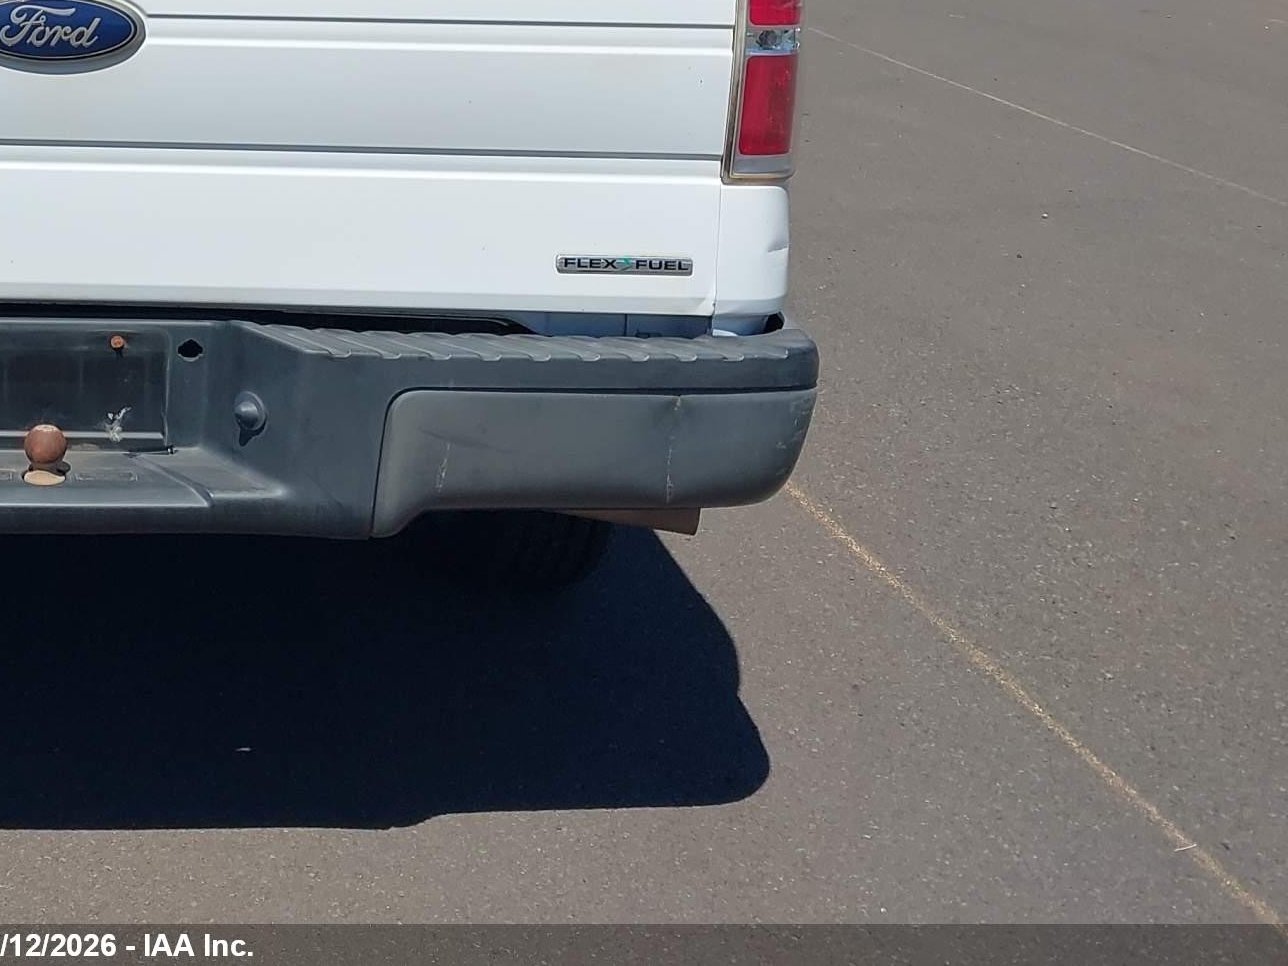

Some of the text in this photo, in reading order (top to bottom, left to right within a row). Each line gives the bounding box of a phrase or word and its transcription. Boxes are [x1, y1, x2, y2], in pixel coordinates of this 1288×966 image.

[0, 4, 102, 48] Ford
[563, 257, 691, 272] FLEX FUEL
